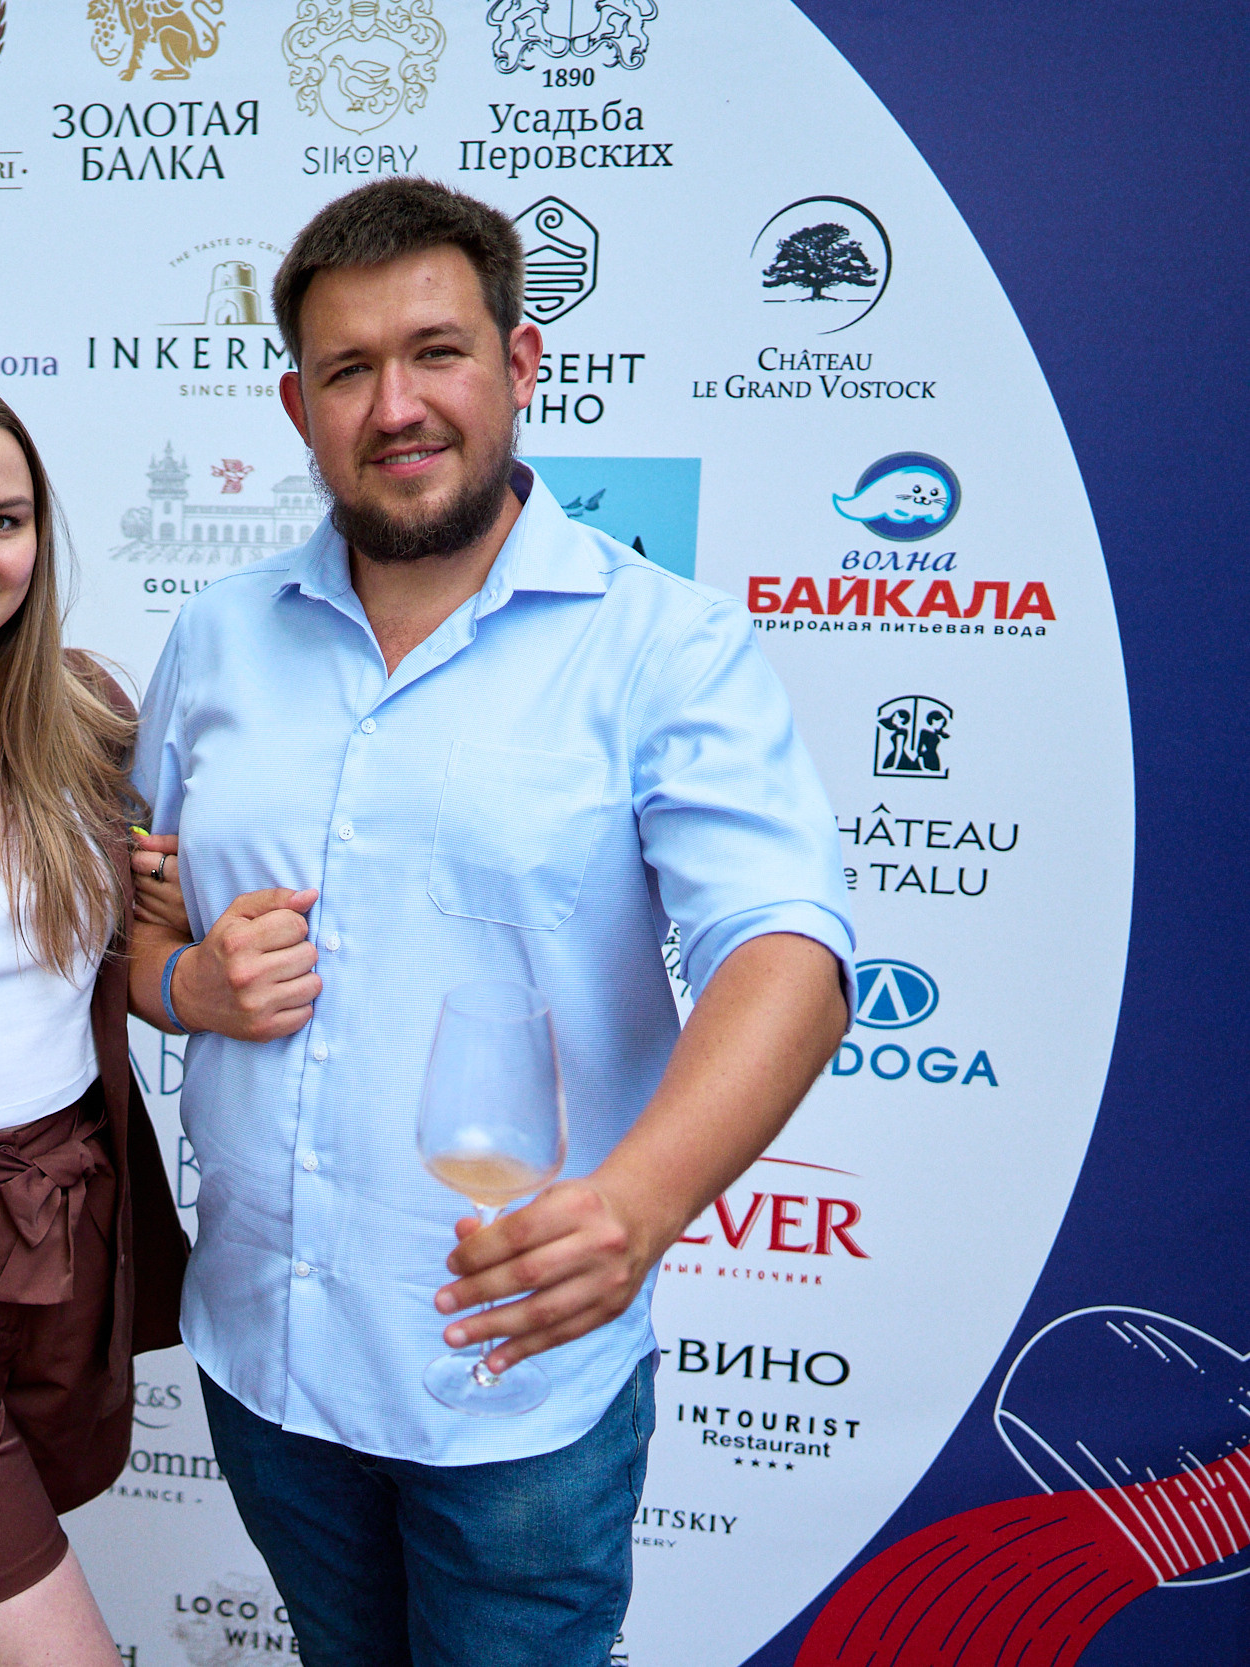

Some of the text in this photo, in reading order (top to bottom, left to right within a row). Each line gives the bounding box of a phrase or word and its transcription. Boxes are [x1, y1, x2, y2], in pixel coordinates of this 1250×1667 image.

[542, 67, 595, 88] 1890
[52, 100, 260, 139] ЗОЛОТАЯ
[488, 99, 644, 140] Усадьба
[81, 144, 225, 182] БАЛКА
[302, 144, 419, 175] SIKORY
[459, 139, 674, 179] Перовских
[169, 238, 286, 268] THE TASTE OF CRIM
[87, 337, 293, 371] INKERM
[536, 354, 645, 383] БЕНТ
[179, 384, 279, 397] SINCE 196
[841, 550, 958, 572] волна
[144, 578, 208, 594] GOLU
[748, 575, 1057, 621] БАЙКАЛА
[753, 618, 1047, 638] природная питьевая вода
[835, 803, 1019, 852] HÂTEAU
[870, 863, 988, 896] TALU
[831, 1041, 999, 1087] DOGA
[664, 1261, 823, 1286] НЫЙ ИСТОЧНИК
[678, 1404, 862, 1439] INTOURIST
[702, 1429, 832, 1459] Restaurant
[131, 1450, 225, 1481] omm
[633, 1507, 738, 1534] ITSKIY
[632, 1536, 677, 1548] NERY
[175, 1593, 259, 1620] LOCO
[224, 1627, 300, 1655] WINE
